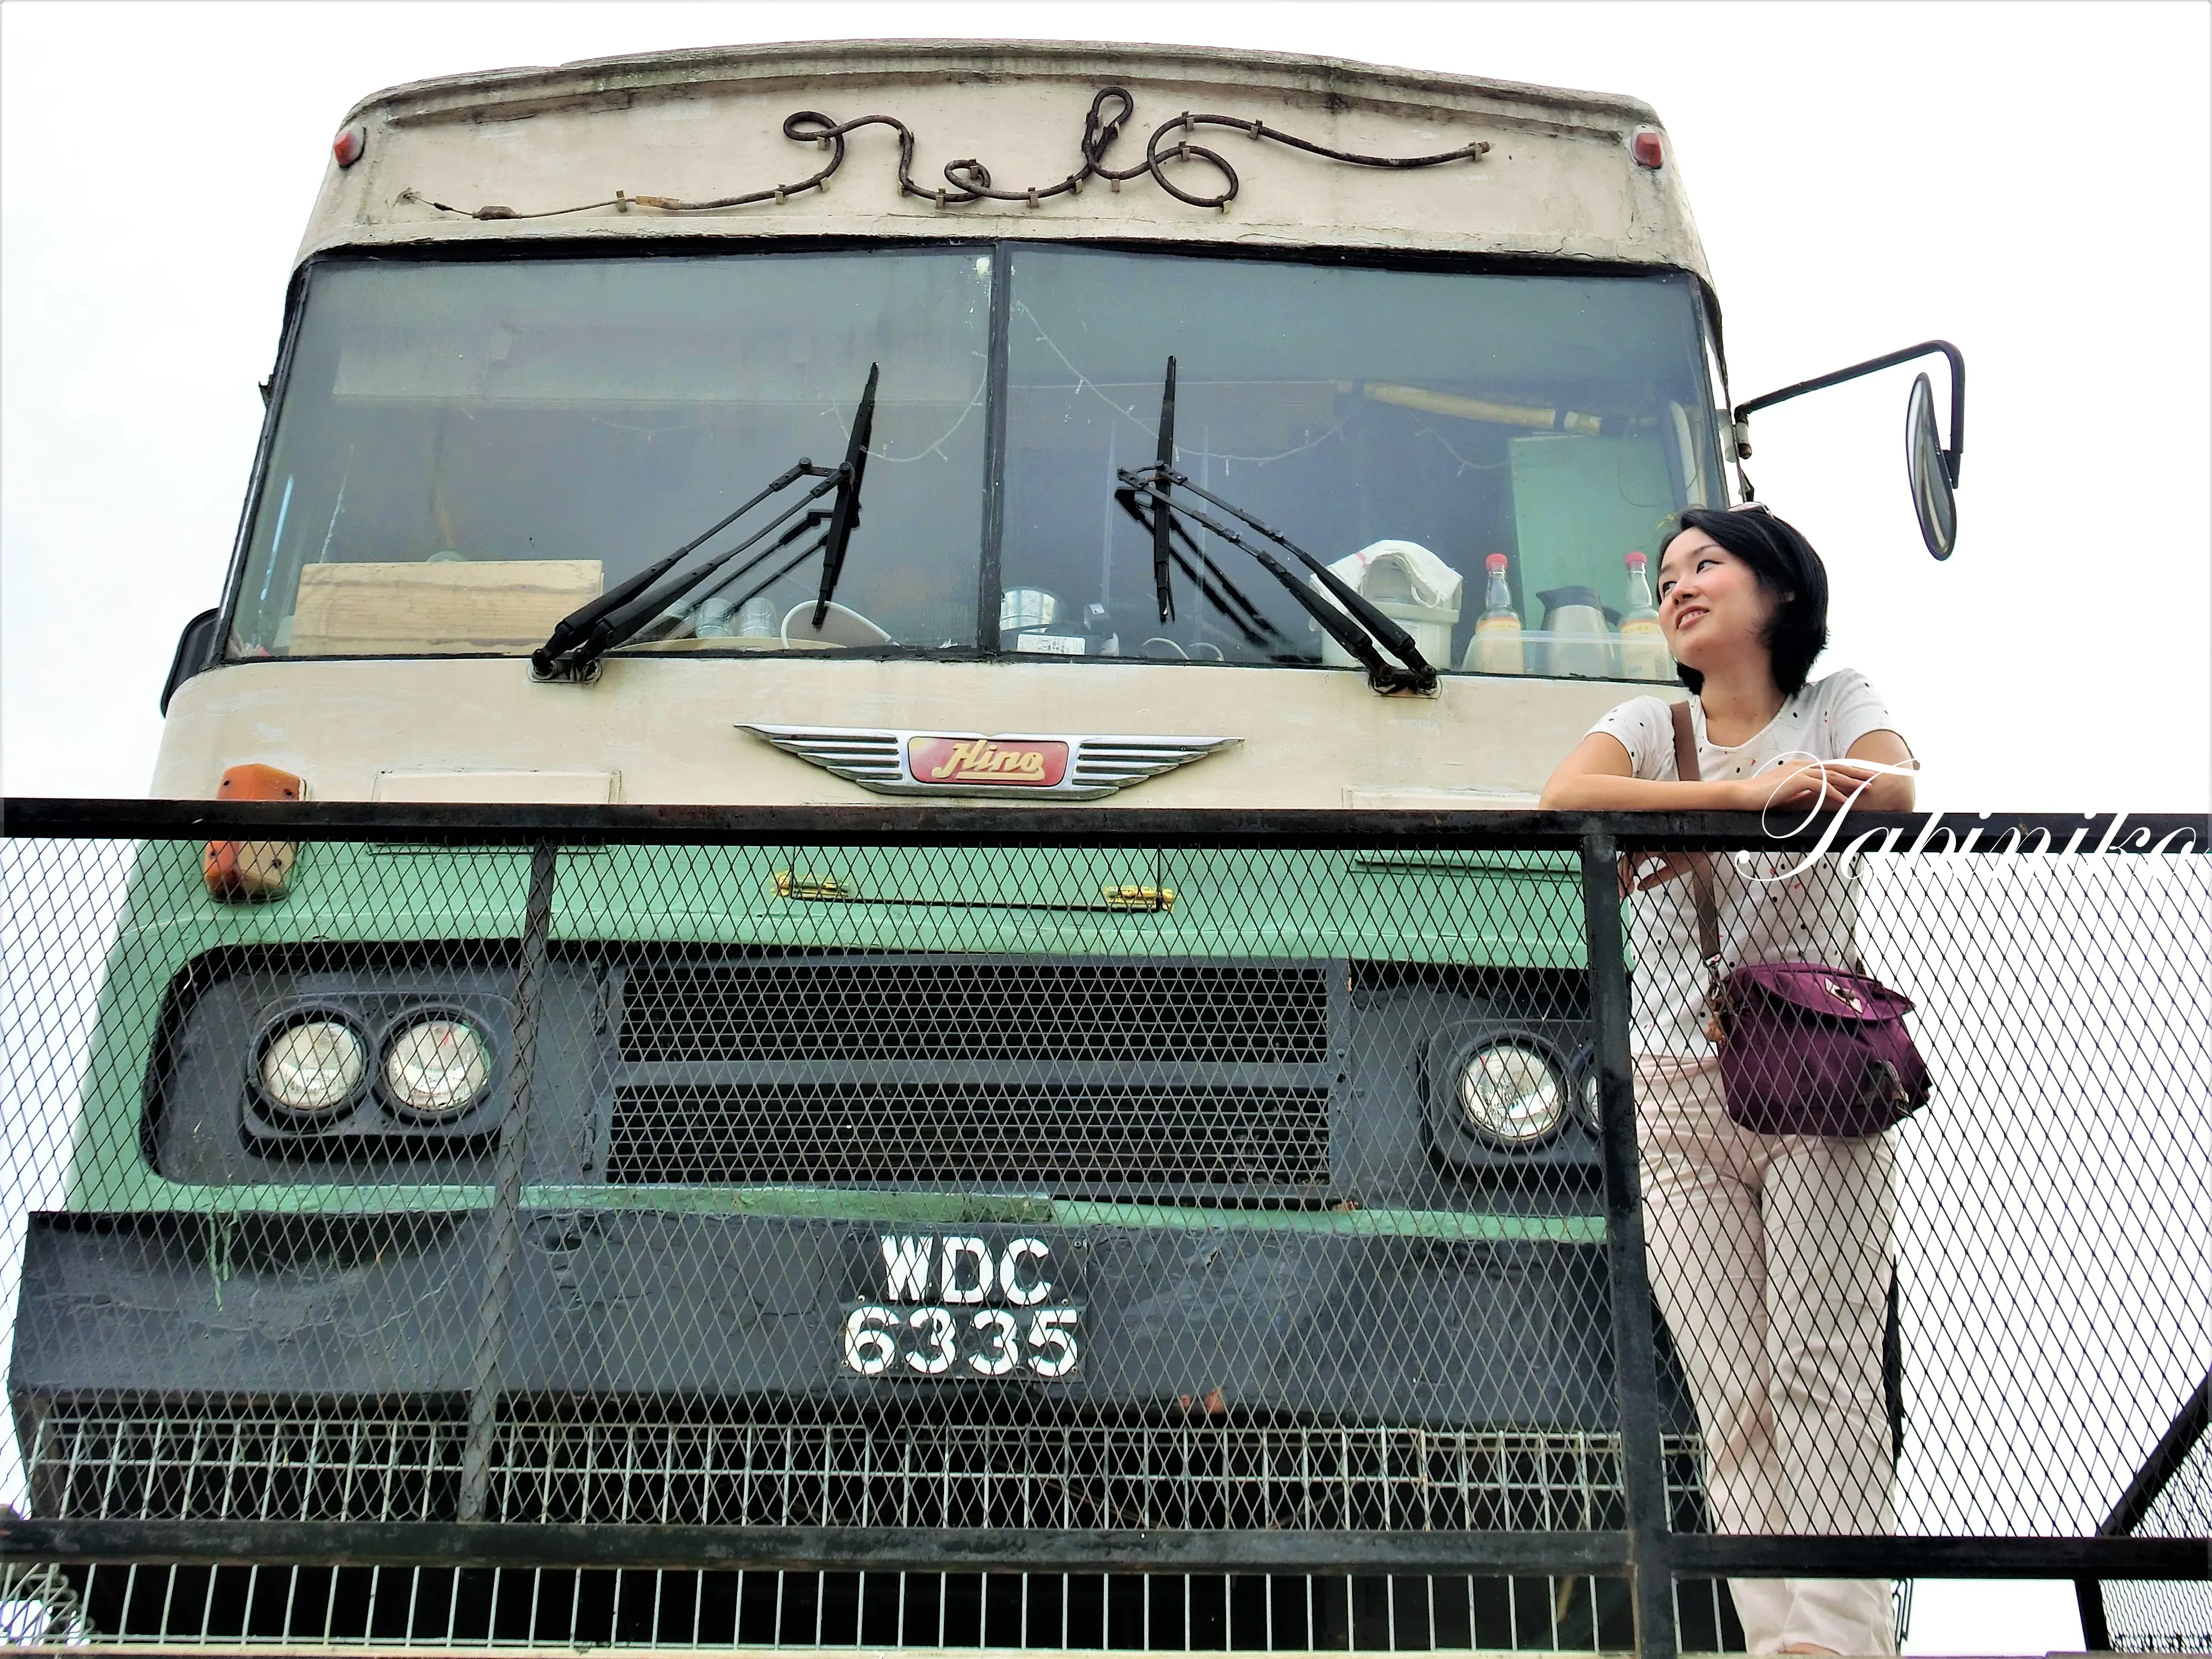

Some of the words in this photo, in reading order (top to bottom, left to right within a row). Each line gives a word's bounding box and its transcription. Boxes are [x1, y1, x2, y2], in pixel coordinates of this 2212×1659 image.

[932, 739, 1045, 780] Hino
[880, 1236, 1051, 1305] WDC
[844, 1306, 1078, 1377] 6335
